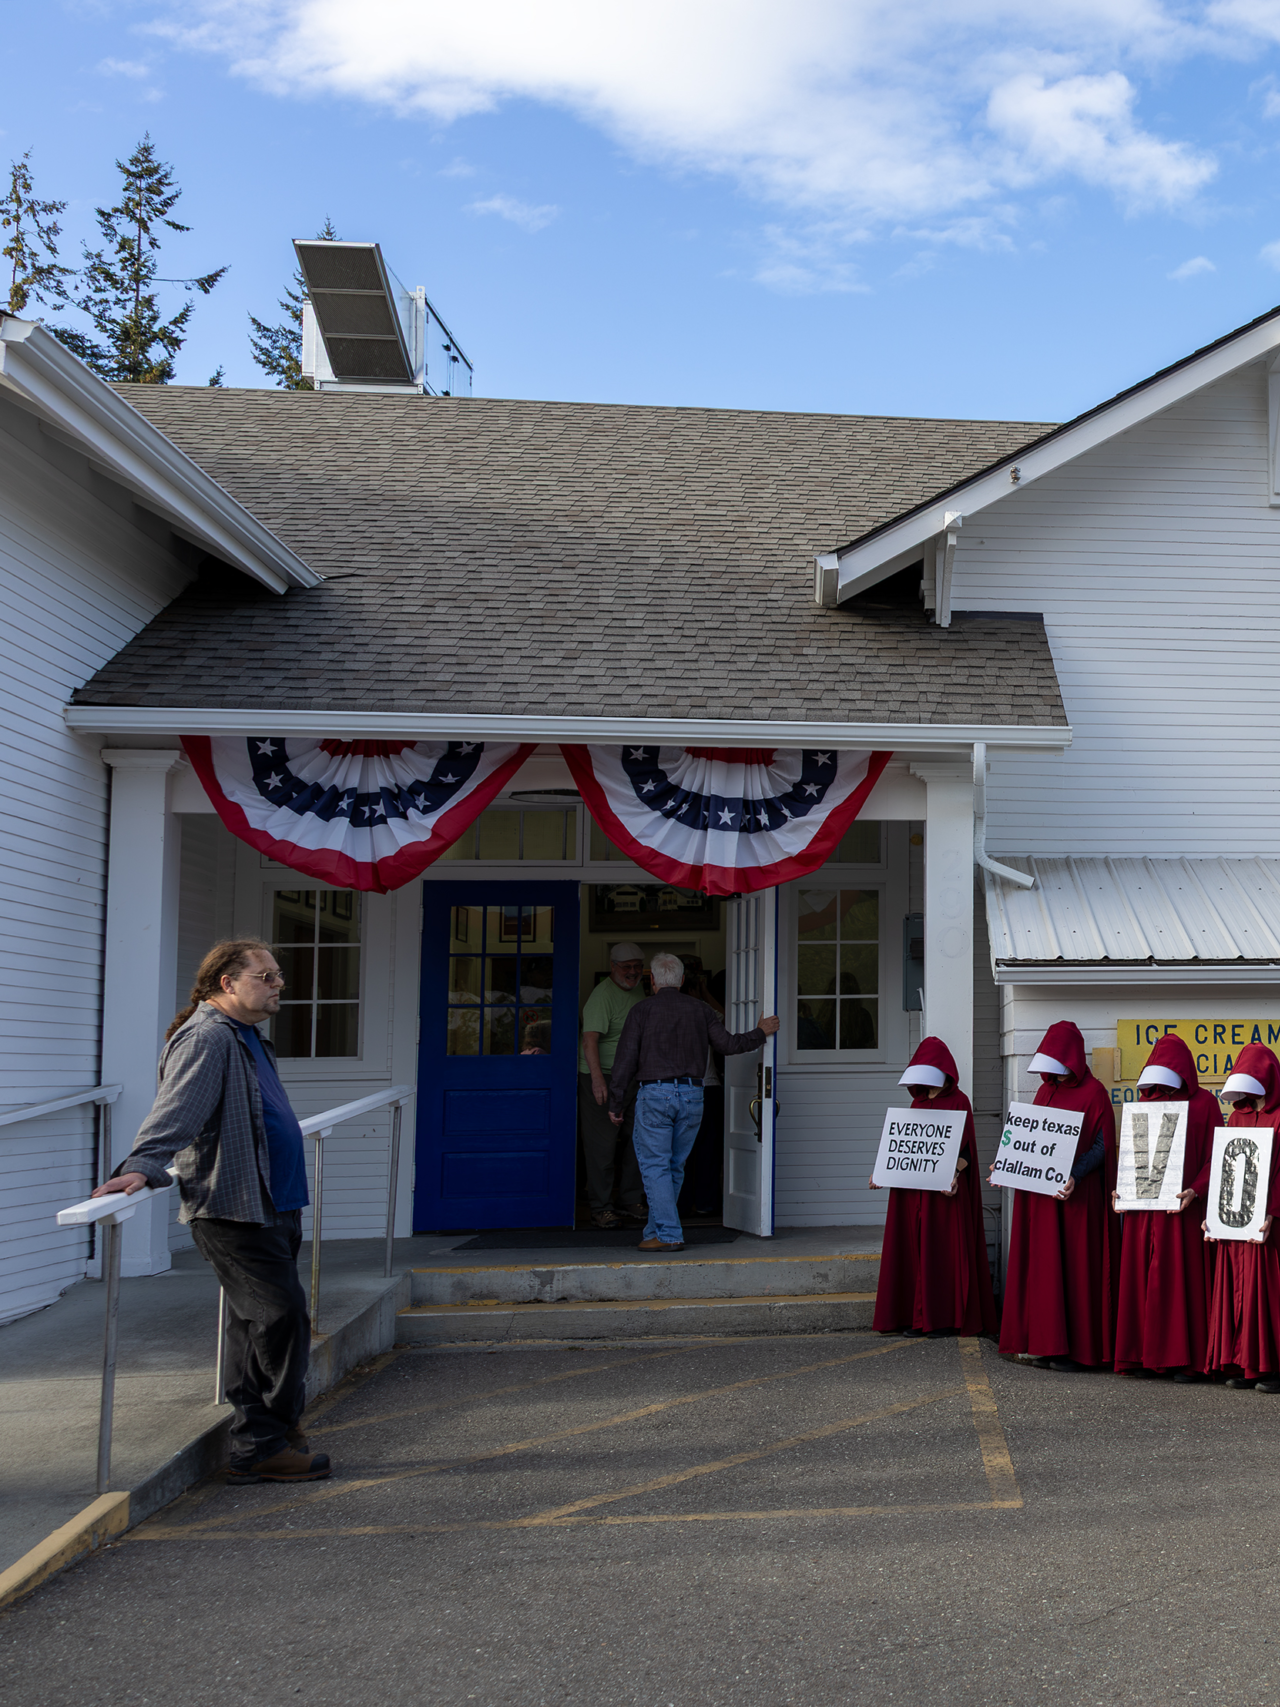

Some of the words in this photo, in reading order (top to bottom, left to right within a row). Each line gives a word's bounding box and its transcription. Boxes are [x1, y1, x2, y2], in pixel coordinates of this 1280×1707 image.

[1197, 1054, 1233, 1074] CIA
[889, 1122, 952, 1139] EVERYONE
[1006, 1112, 1039, 1132] keep
[1042, 1118, 1080, 1136] texas
[888, 1139, 945, 1156] DESERVES
[1001, 1129, 1012, 1147] $
[1013, 1140, 1036, 1153] out
[1041, 1143, 1057, 1156] of
[886, 1156, 940, 1173] DIGNITY
[1131, 1113, 1181, 1199] V
[994, 1158, 1042, 1179] clallam
[1045, 1167, 1067, 1184] Co.
[1217, 1138, 1260, 1228] O
